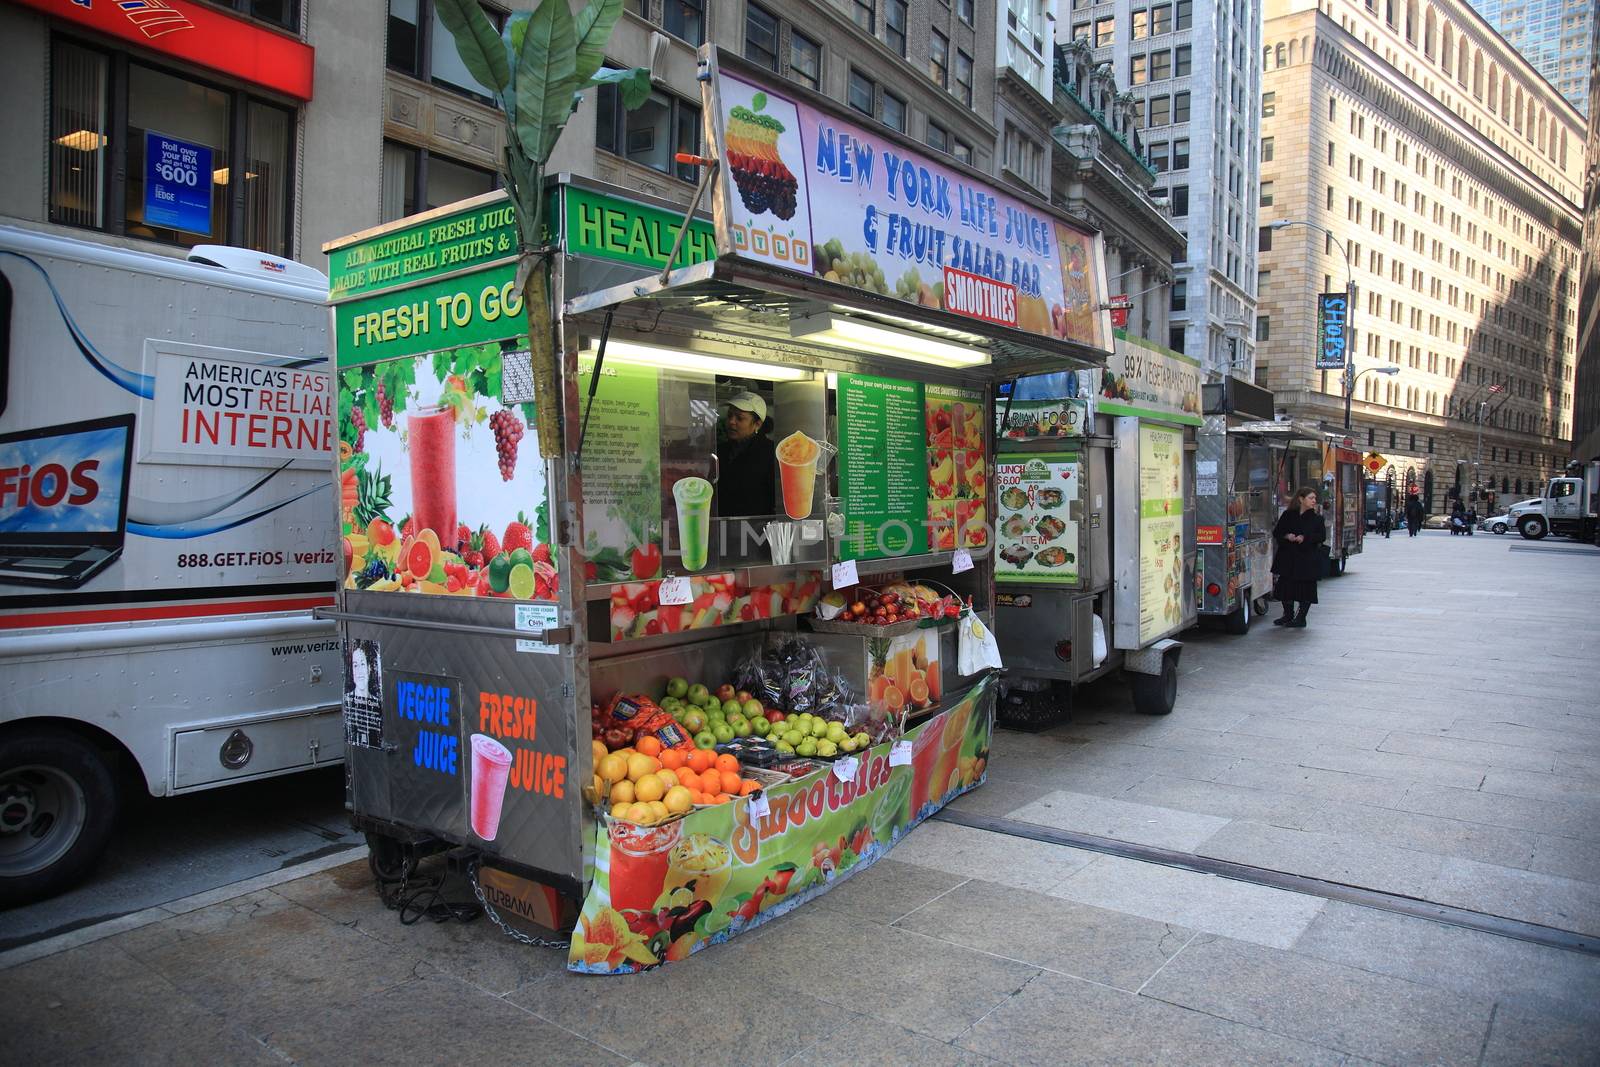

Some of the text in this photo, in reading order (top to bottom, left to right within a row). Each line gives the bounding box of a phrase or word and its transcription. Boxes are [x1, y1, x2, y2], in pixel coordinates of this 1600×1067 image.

[162, 141, 198, 157] Roll over
[162, 151, 198, 165] your IRA
[817, 122, 1050, 258] NEW YORK LIFE JUICE
[345, 206, 516, 268] ALL NATURAL FRESH JUIC
[863, 204, 1042, 298] & FRUIT SALAD BAR
[334, 273, 366, 291] MADE
[368, 262, 401, 284] WITH
[403, 252, 438, 275] REAL
[441, 235, 494, 266] FRUITS
[497, 233, 510, 251] &
[353, 282, 524, 347] FRESH TO GO
[947, 272, 1016, 323] SMOOTHIES
[1324, 299, 1346, 357] SHOPS
[186, 362, 287, 388] AMERICA'S
[1124, 355, 1143, 379] 99%
[184, 383, 253, 409] MOST
[1043, 410, 1078, 426] FOOD
[0, 460, 100, 508] FiOS
[177, 549, 336, 567] 888.GET.FiOS veriz
[397, 680, 450, 726] VEGGIE
[479, 692, 537, 741] FRESH
[413, 730, 458, 775] JUICE
[510, 747, 567, 800] JUICE
[484, 884, 535, 920] TURBANA
